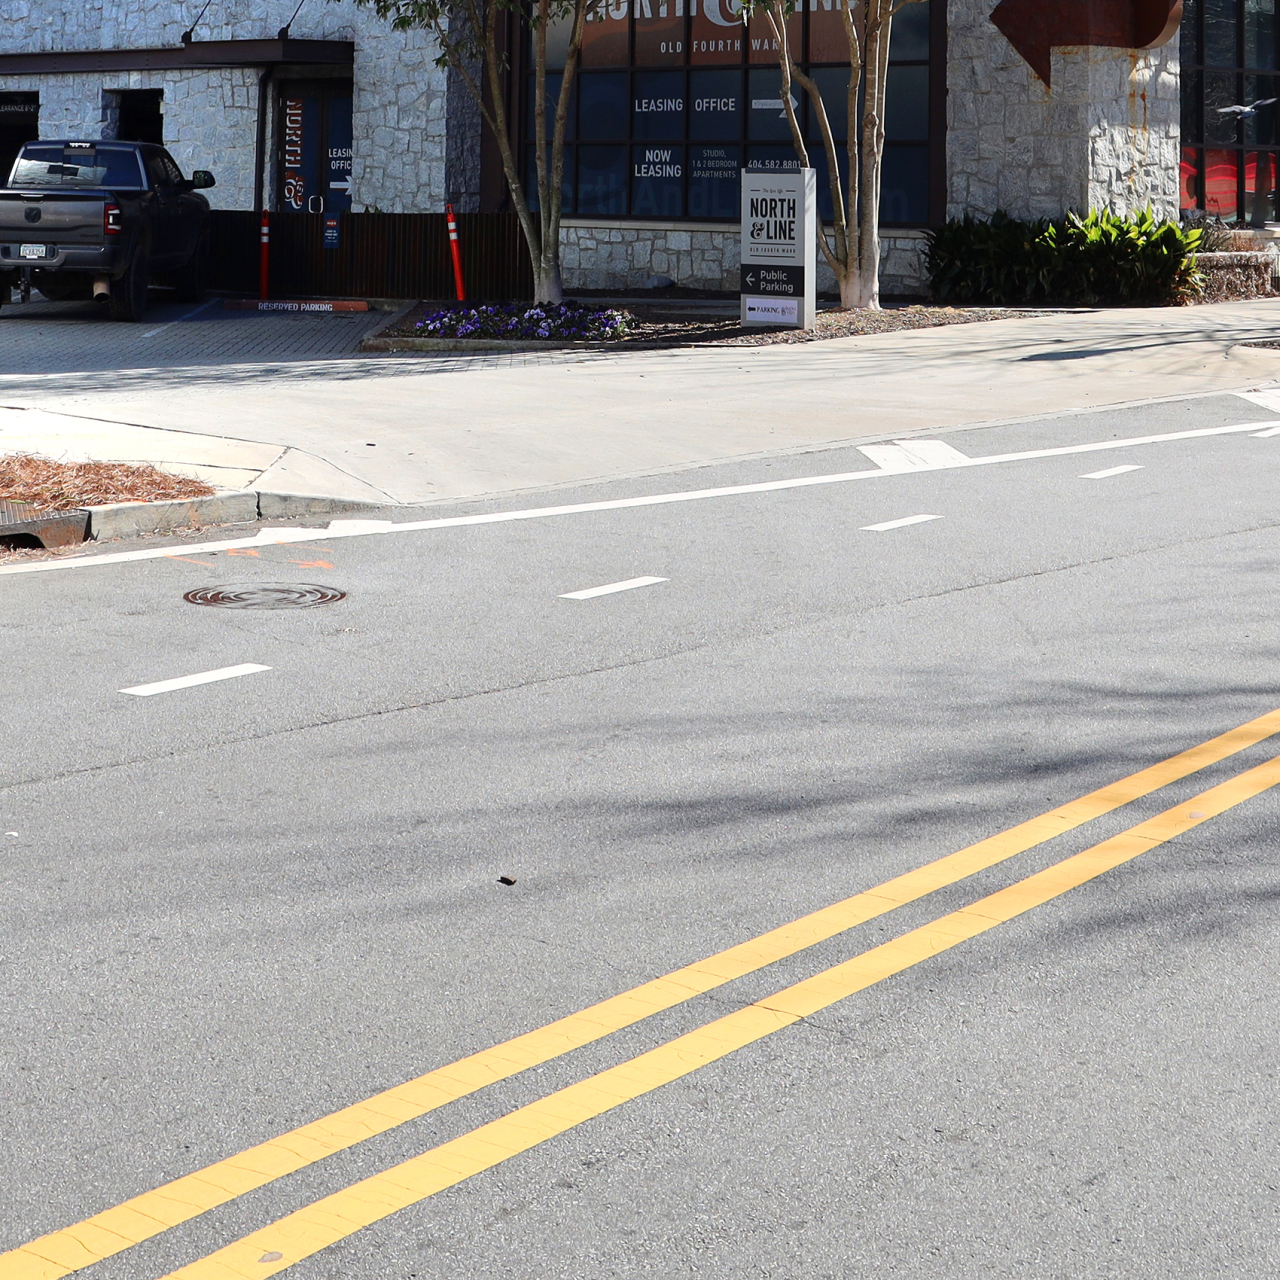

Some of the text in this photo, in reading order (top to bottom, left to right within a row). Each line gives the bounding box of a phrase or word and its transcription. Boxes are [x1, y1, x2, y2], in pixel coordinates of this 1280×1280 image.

[660, 39, 780, 53] OLD FOURTH WAR
[635, 98, 736, 113] LEASING OFFICE
[285, 99, 303, 168] NORTH
[328, 148, 353, 158] LEASIN
[645, 150, 671, 162] NOW
[331, 161, 352, 170] OFFIC
[707, 160, 737, 168] BEDROOM
[748, 160, 801, 169] 404.582.8801
[634, 164, 682, 178] LEASING
[750, 198, 796, 218] NORTH
[750, 220, 795, 240] & LINE
[760, 270, 787, 280] Public
[760, 281, 794, 294] Parking
[258, 302, 333, 312] RESERVED PARKING
[756, 306, 780, 314] PARKING
